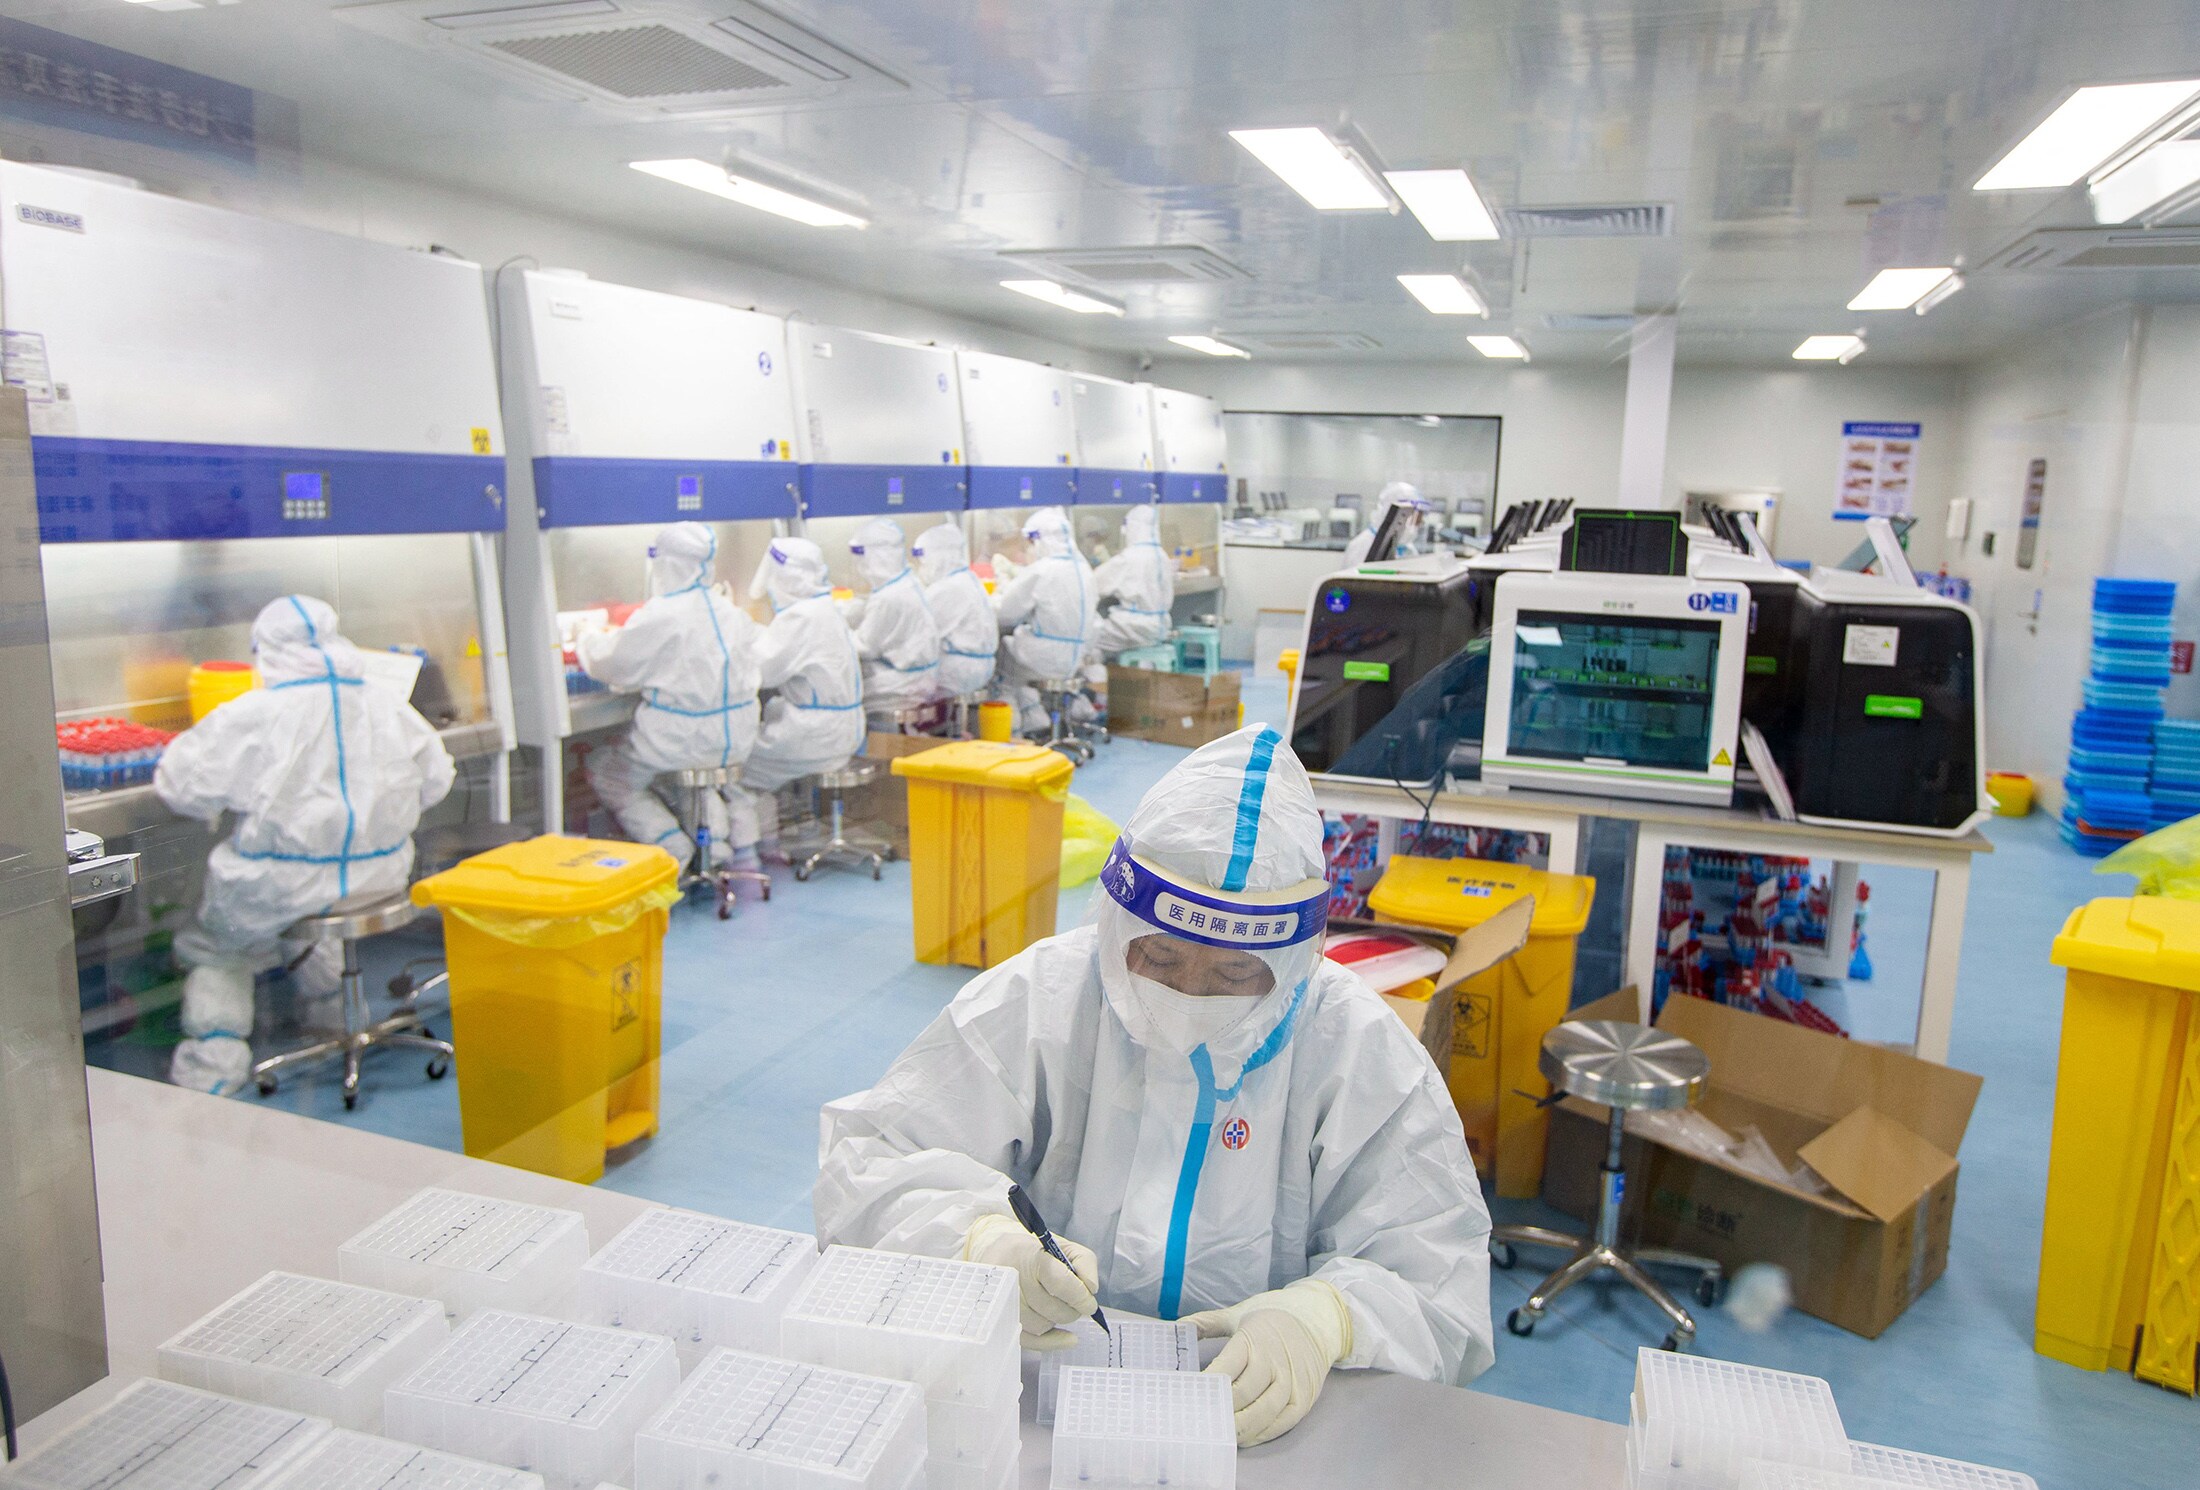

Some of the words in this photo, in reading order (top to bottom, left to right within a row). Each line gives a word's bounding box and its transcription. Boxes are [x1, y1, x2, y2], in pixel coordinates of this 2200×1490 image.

[21, 207, 82, 229] BIOBASE
[1168, 903, 1288, 937] 医用隔离面罩
